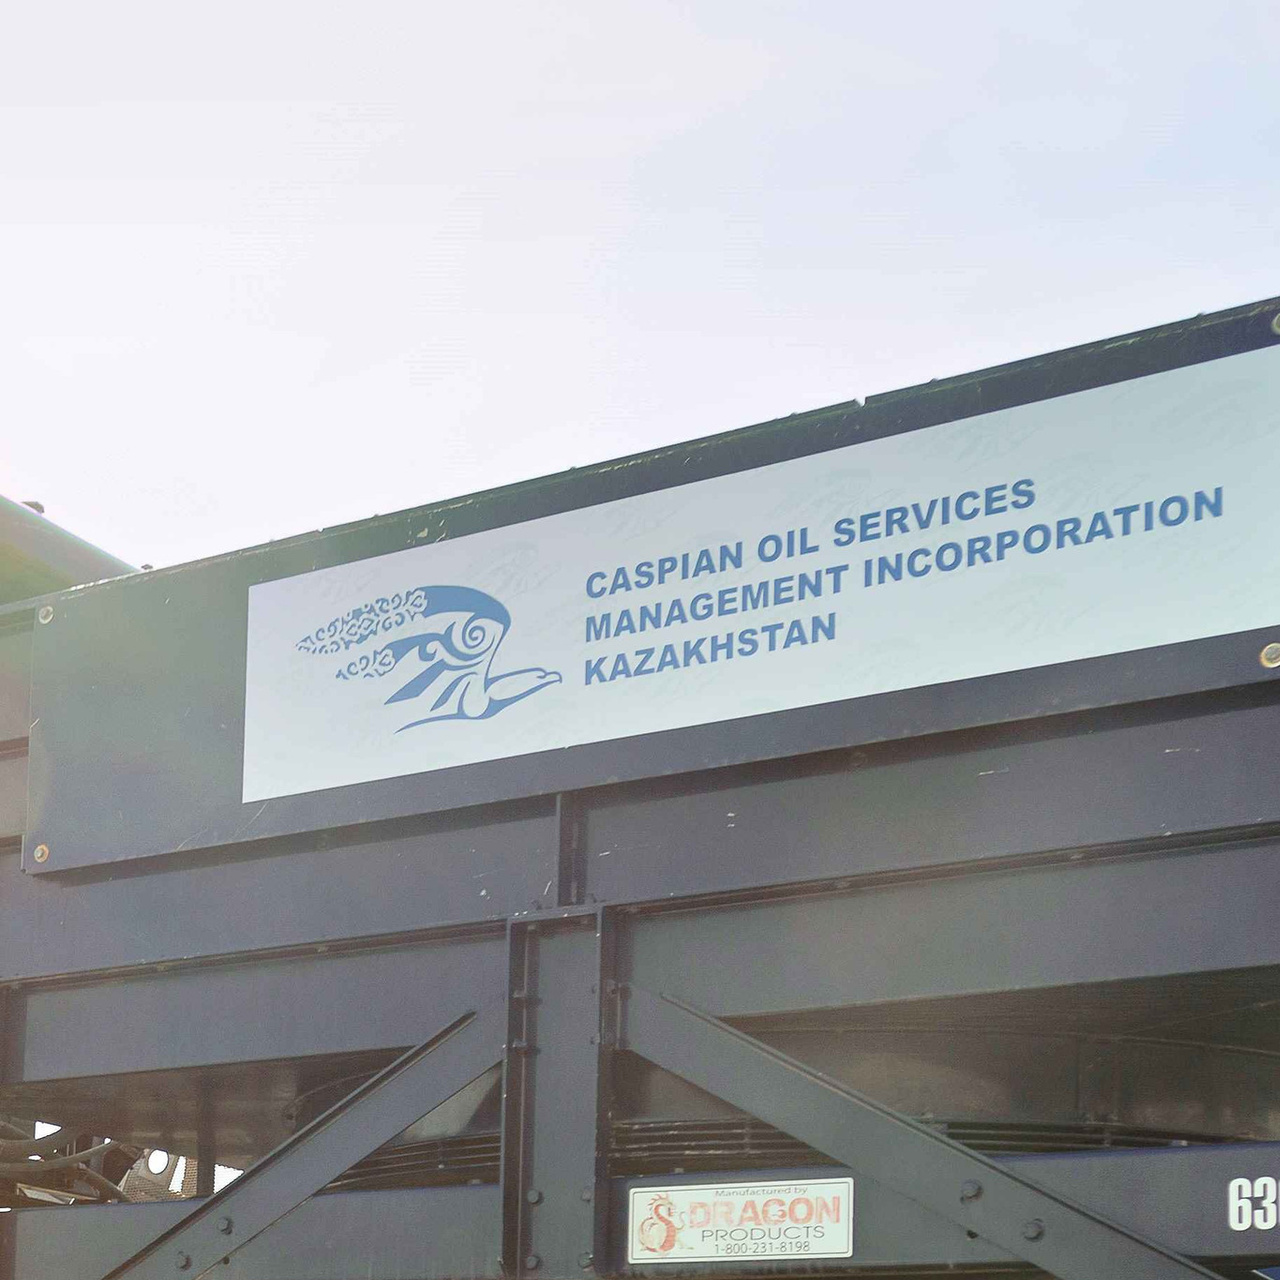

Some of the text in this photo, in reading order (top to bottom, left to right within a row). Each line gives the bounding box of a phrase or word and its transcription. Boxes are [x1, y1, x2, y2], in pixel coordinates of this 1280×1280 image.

[585, 478, 1035, 600] CASPIAN OIL SERVICES
[586, 486, 1224, 641] MANAGEMENT INCORPORATION
[585, 612, 836, 685] KAZAKHSTAN
[689, 1196, 841, 1228] DRAGON
[714, 1186, 809, 1198] Manufactured by
[1228, 1176, 1280, 1231] 63
[701, 1226, 826, 1242] PRODUCTS
[714, 1241, 811, 1255] 1-800-231-8198
